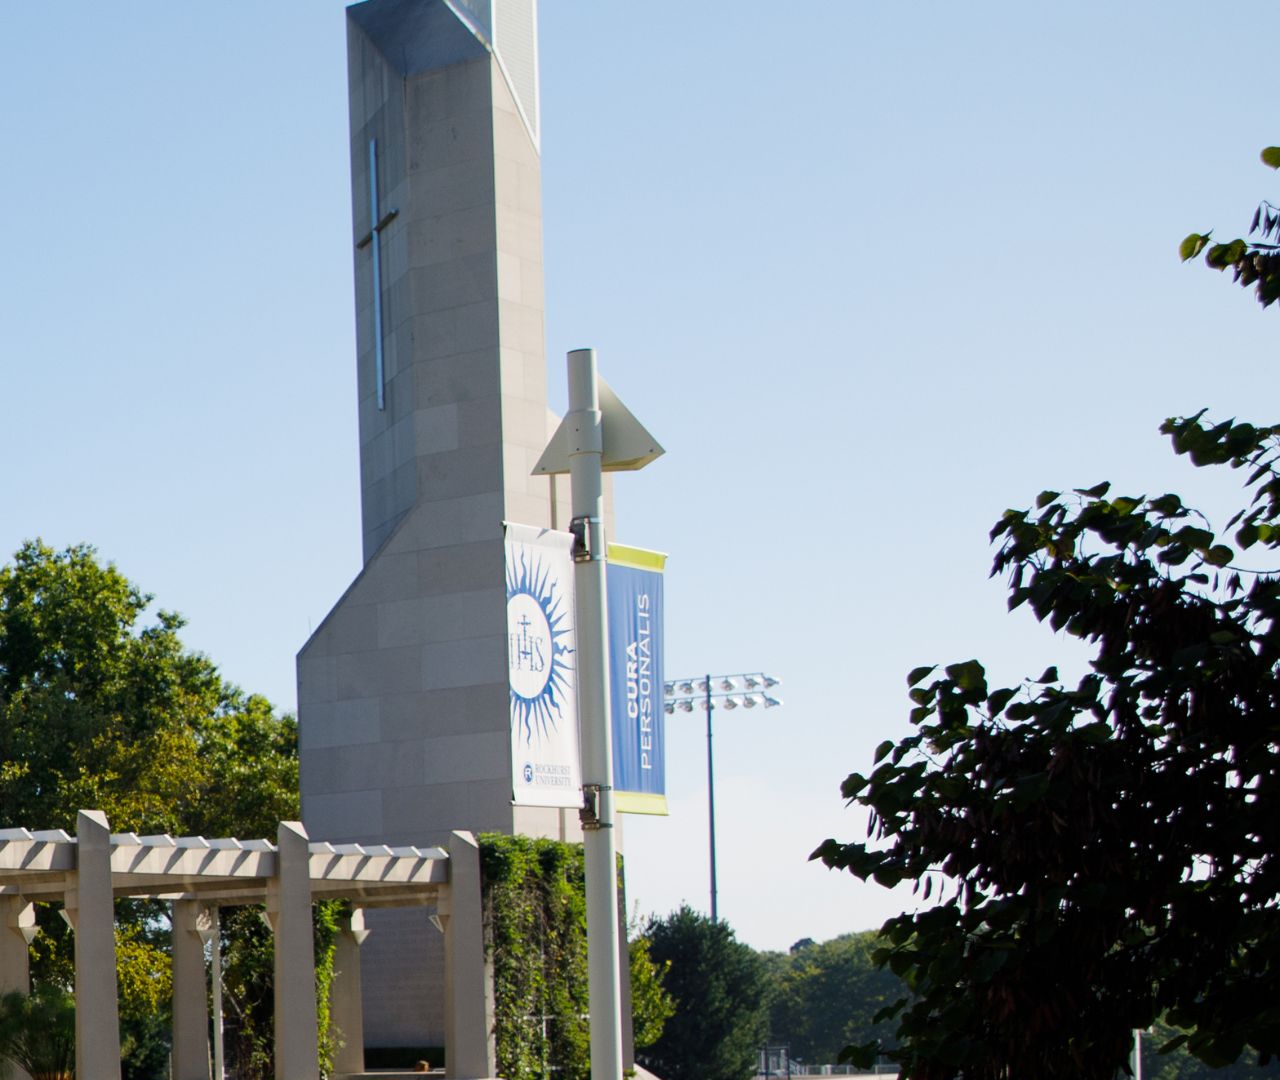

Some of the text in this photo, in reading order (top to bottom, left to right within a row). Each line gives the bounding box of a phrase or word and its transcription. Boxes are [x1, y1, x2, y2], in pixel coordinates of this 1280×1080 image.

[626, 641, 638, 719] CURA
[638, 594, 652, 769] PERSONALIS
[535, 763, 571, 775] ROCKHURST
